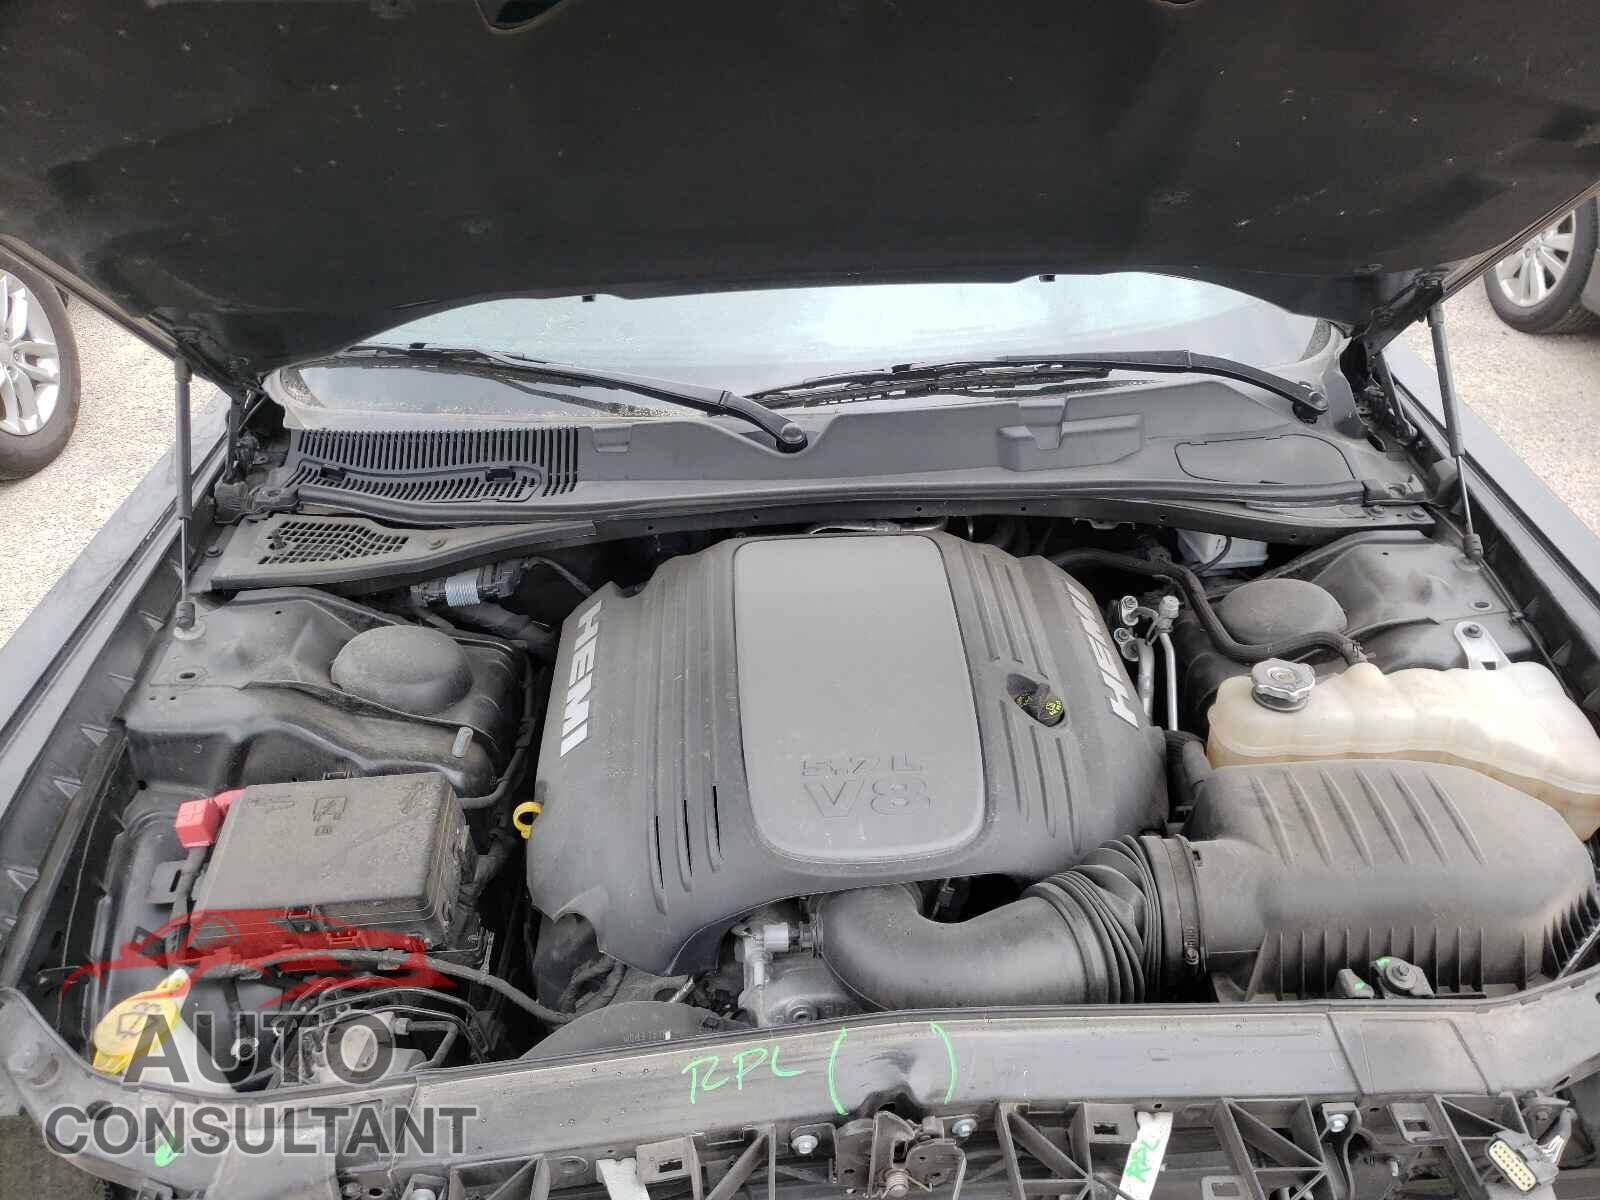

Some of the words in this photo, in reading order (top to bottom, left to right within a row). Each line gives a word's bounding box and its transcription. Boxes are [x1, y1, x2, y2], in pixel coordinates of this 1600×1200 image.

[559, 600, 602, 758] HEMI
[1065, 578, 1139, 728] HEMI
[803, 777, 932, 818] V8
